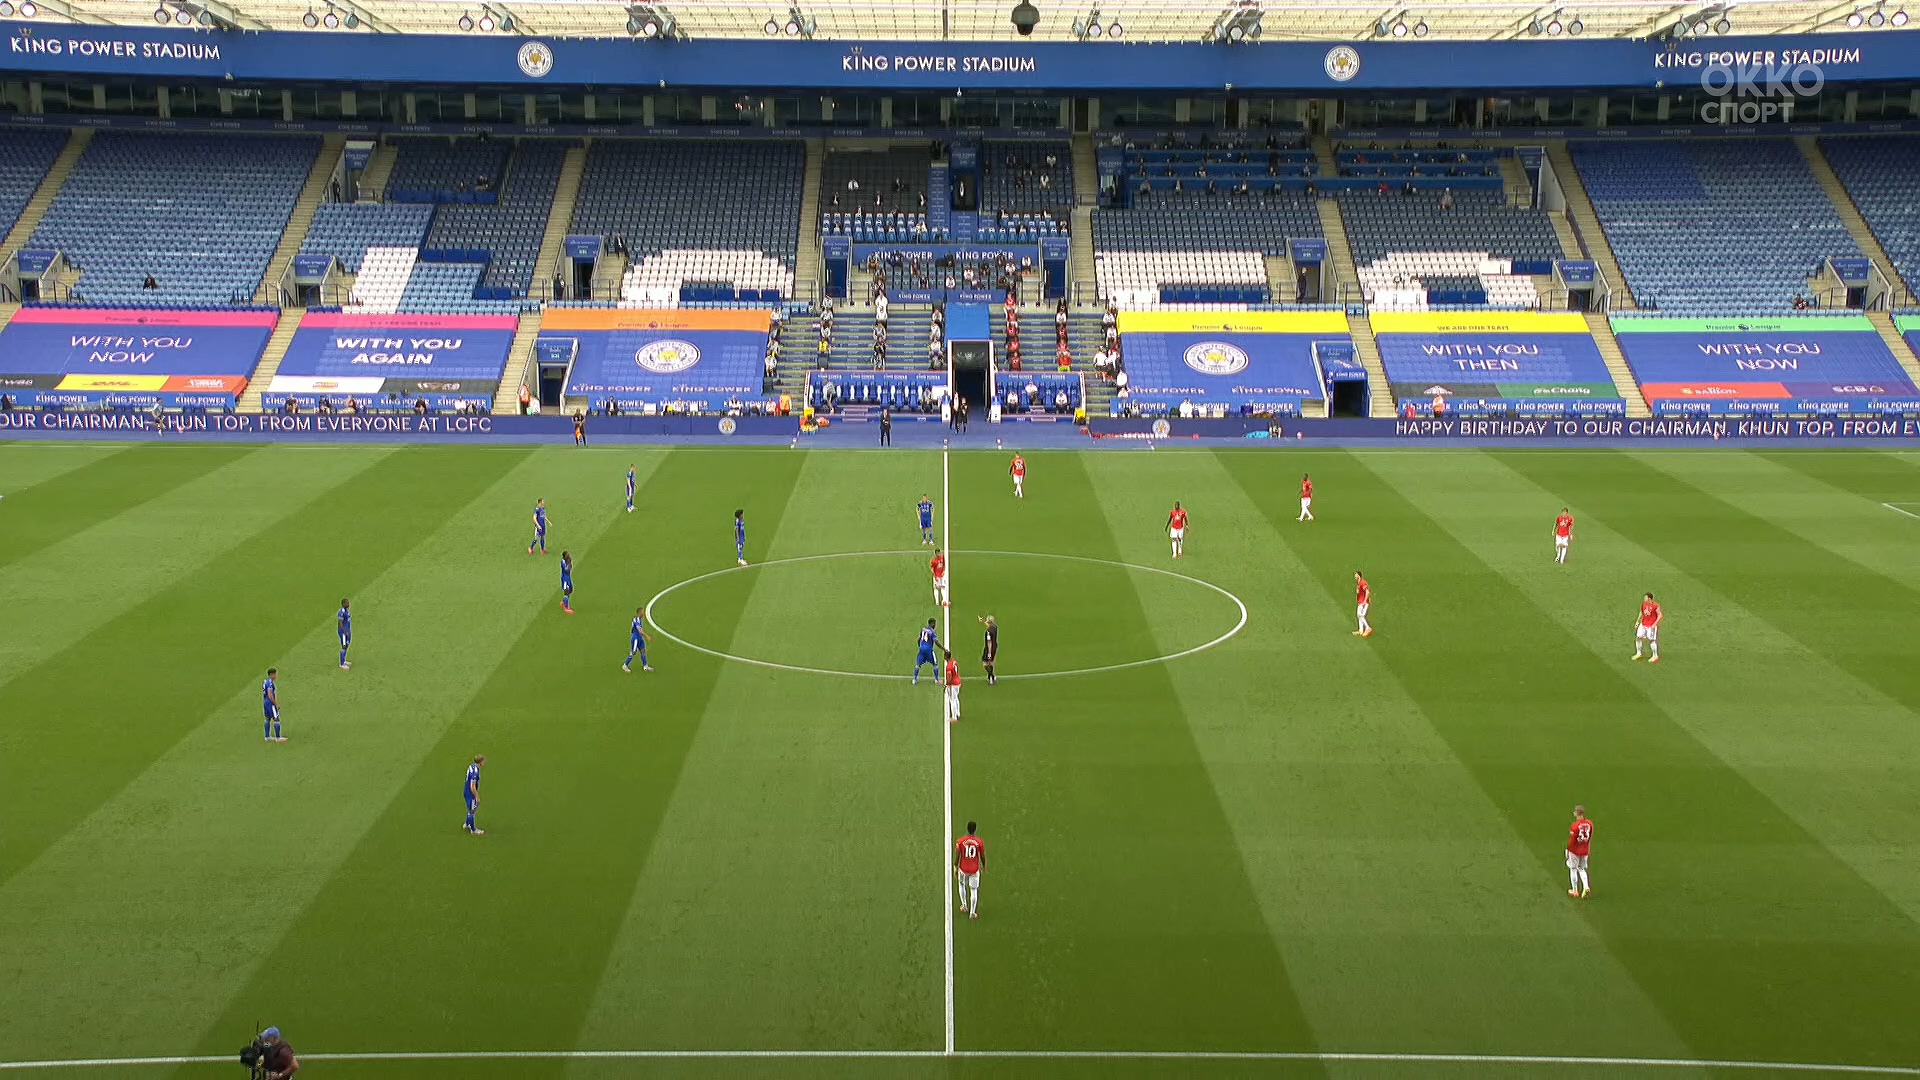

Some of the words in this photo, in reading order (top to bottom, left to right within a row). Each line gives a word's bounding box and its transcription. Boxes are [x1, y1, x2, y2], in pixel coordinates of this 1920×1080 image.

[11, 37, 62, 54] KING
[68, 40, 136, 57] POWER
[143, 42, 221, 60] STADIUM
[842, 56, 888, 70] KING
[895, 56, 956, 71] POWER
[963, 57, 1035, 72] STADIUM
[1654, 52, 1702, 68] KING
[1708, 50, 1775, 66] POWER
[1781, 48, 1860, 65] STADIUM
[874, 251, 890, 259] KIN
[956, 251, 979, 260] KING
[71, 336, 134, 348] WITH
[142, 337, 192, 348] YOU
[336, 338, 404, 349] WITH
[410, 338, 463, 350] YOU
[1422, 344, 1482, 355] WITH
[1488, 344, 1539, 355] YOU
[1698, 343, 1760, 355] WITH
[1767, 343, 1821, 355] YOU
[89, 352, 155, 363] NOW
[352, 353, 434, 364] AGAIN
[1453, 359, 1518, 370] THEN
[1736, 358, 1798, 370] NOW
[43, 414, 150, 430] CHAIRMAN,
[213, 416, 252, 432] TOP,
[260, 416, 311, 430] FROM
[318, 416, 412, 431] EVERYONE
[418, 417, 439, 431] AT
[446, 417, 492, 432] LCFC
[1396, 421, 1454, 435] HAPPY
[1460, 421, 1548, 435] BIRTHDAY
[1554, 422, 1577, 435] TO
[1584, 422, 1622, 435] OUR
[1629, 421, 1730, 436] CHAIRMAN,
[1739, 421, 1788, 435] KHUN
[1796, 421, 1834, 436] TOP,
[1843, 420, 1897, 434] FROM
[921, 630, 929, 642] 14
[966, 844, 976, 858] 10
